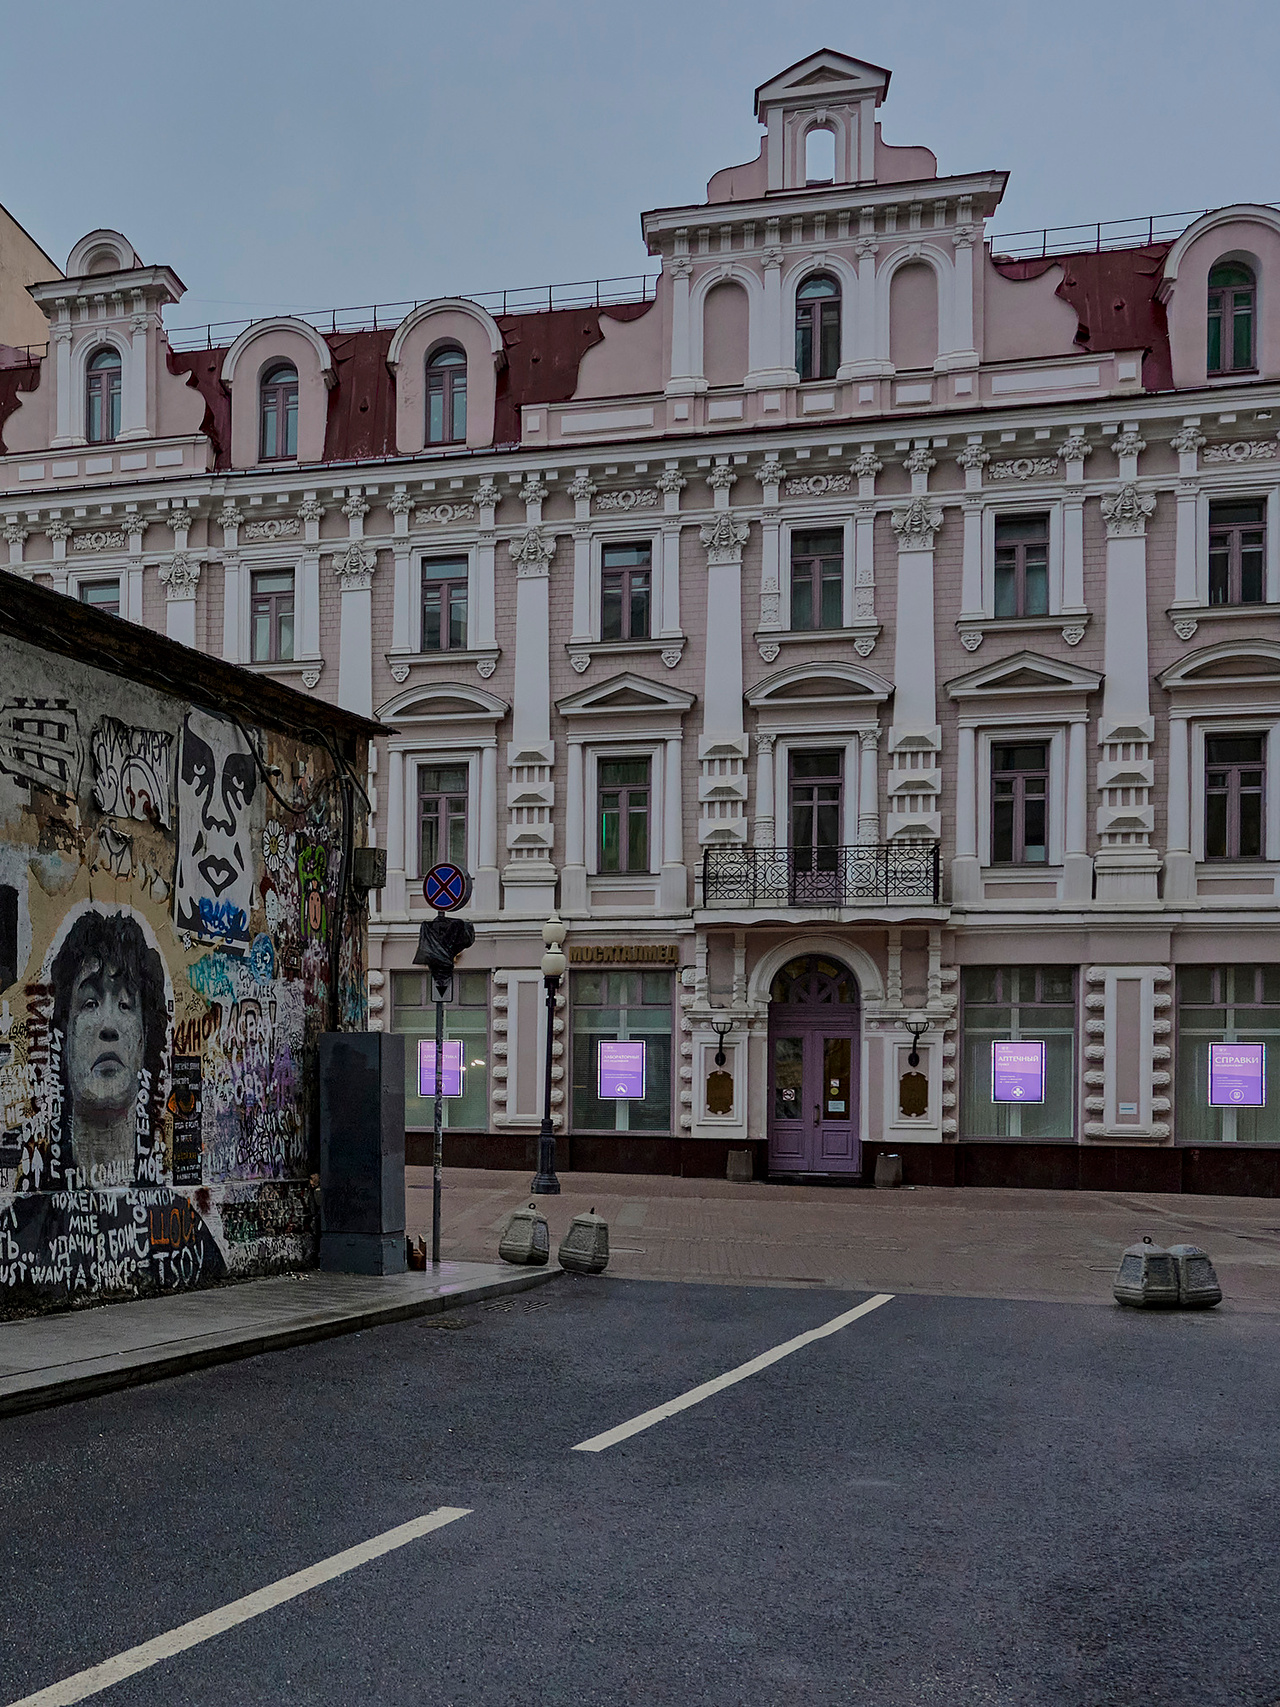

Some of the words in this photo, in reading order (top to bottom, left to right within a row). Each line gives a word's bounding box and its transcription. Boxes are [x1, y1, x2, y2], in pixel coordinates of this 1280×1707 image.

[569, 945, 679, 964] МОСИТАЛМЕД
[998, 1054, 1039, 1062] АПТЕЧНЫЙ
[1215, 1056, 1259, 1064] СПРАВКИ
[69, 1214, 100, 1235] МНЕ
[149, 1197, 196, 1249] ЦОЙ
[153, 1239, 204, 1289] TSOY
[73, 1264, 88, 1291] A
